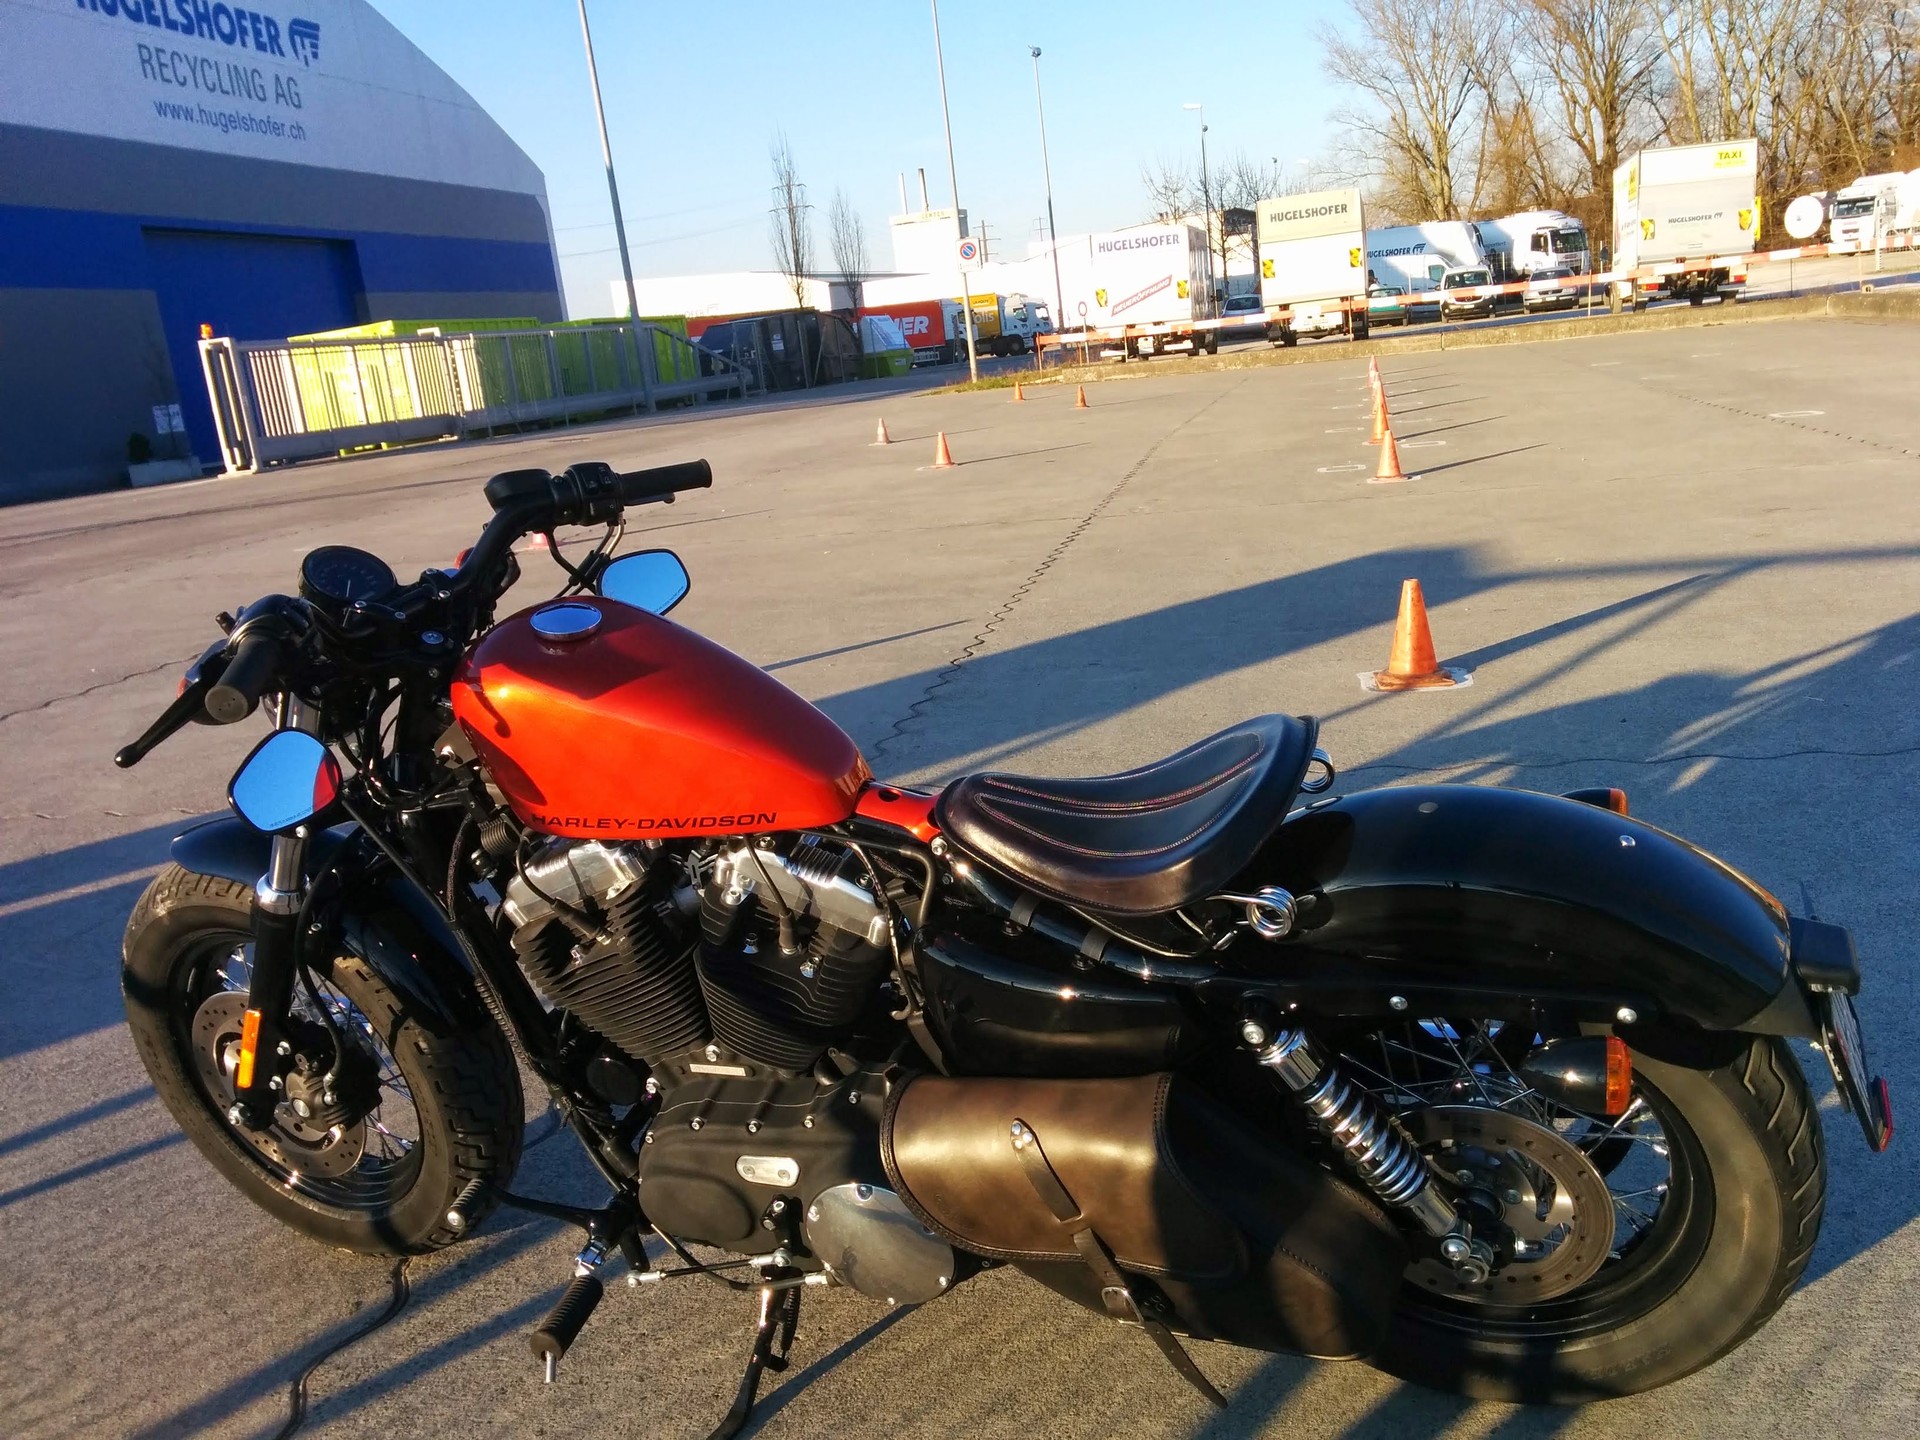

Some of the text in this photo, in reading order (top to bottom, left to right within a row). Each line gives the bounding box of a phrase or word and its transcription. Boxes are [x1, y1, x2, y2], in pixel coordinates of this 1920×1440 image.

[137, 43, 302, 109] RECYCLING AG
[153, 100, 306, 141] www.hugelshofer.ch
[1717, 150, 1743, 160] TAXI
[1270, 203, 1348, 223] HUGELSHOFER
[1668, 214, 1713, 224] HUGELSHOFER
[1098, 234, 1180, 253] HUGELSHOFER
[532, 811, 777, 830] HARLEY-DAVIDSON
